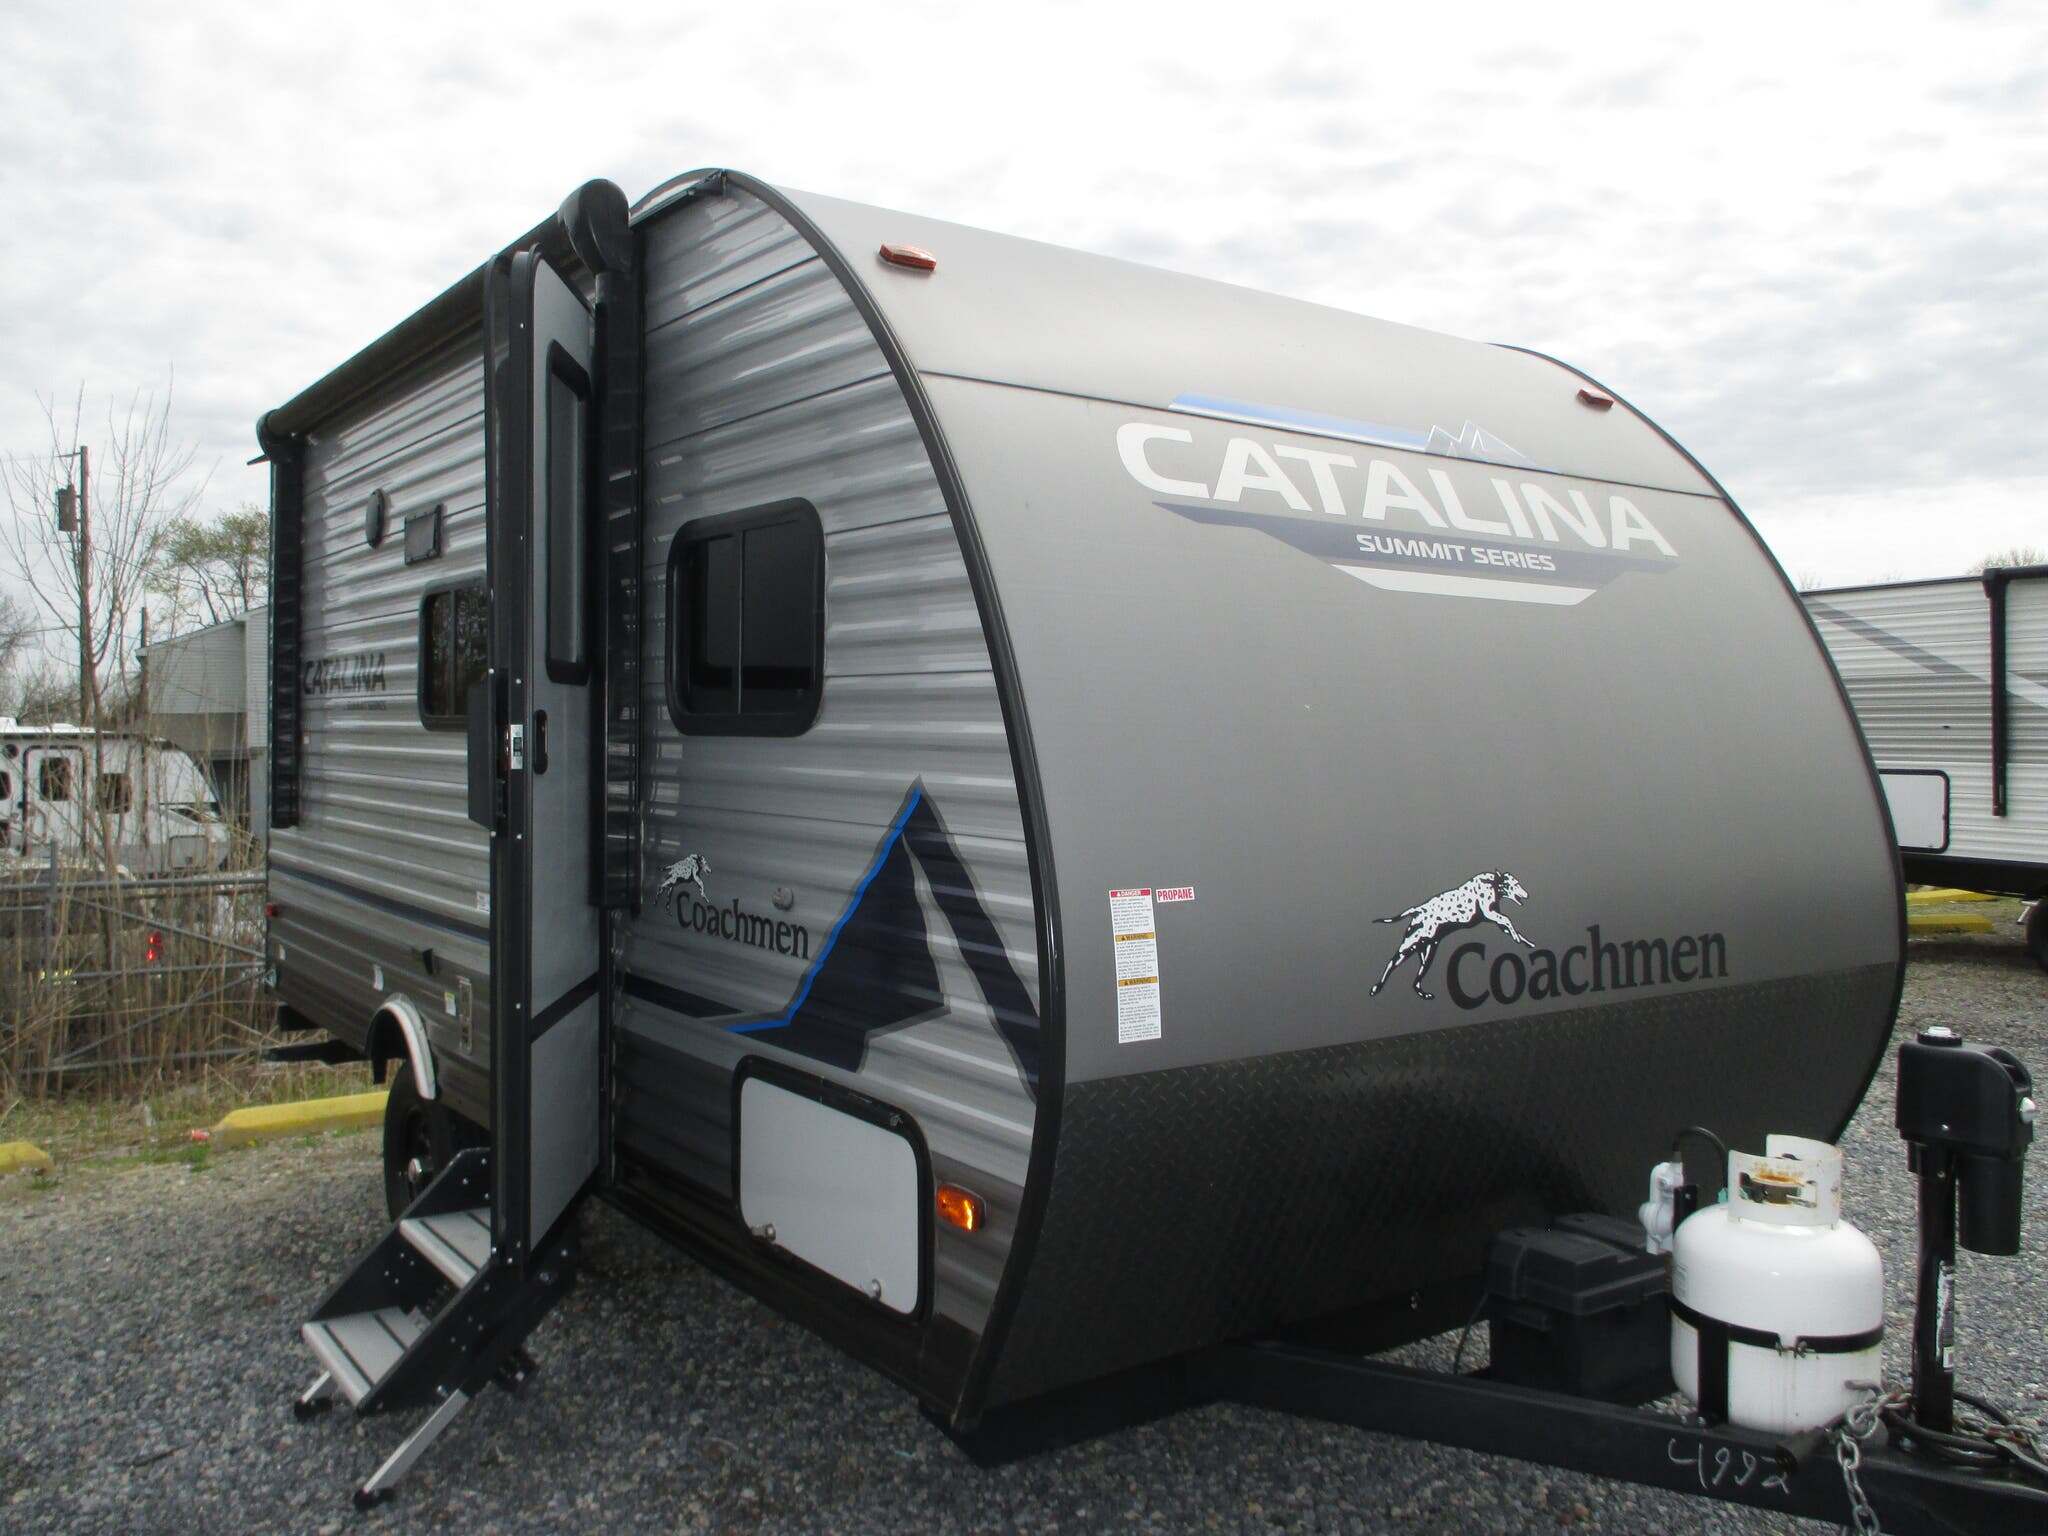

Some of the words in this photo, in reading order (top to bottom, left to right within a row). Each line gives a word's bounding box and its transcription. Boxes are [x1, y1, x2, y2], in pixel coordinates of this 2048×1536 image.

[1116, 422, 1679, 557] CATALINA
[1356, 534, 1465, 562] SUMMIT
[1470, 547, 1556, 572] SERIES
[303, 652, 386, 695] CATALINA
[1157, 888, 1193, 902] PROPANE
[676, 890, 809, 960] Coachmen
[1446, 925, 1729, 1010] Coachmen
